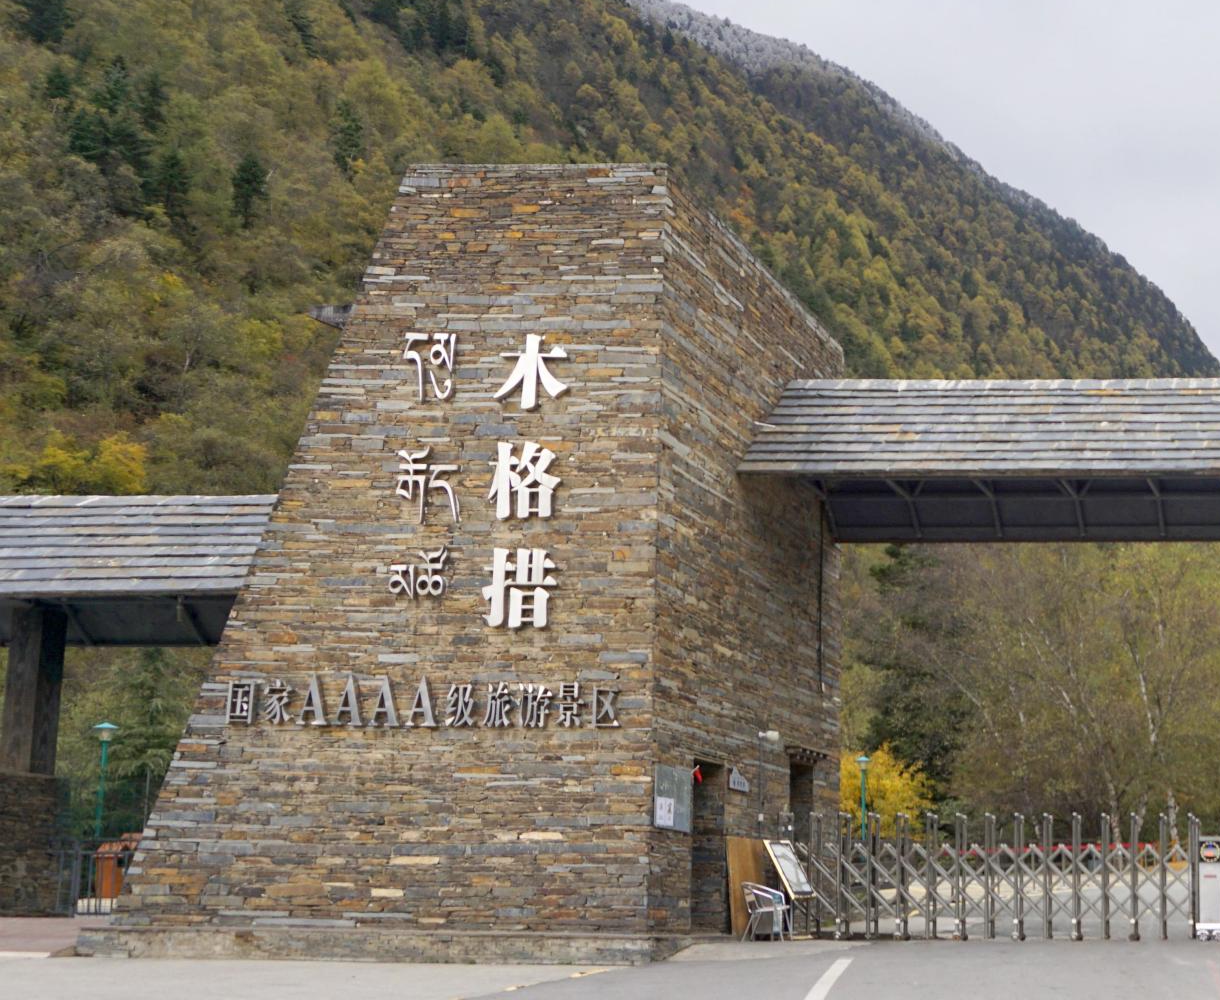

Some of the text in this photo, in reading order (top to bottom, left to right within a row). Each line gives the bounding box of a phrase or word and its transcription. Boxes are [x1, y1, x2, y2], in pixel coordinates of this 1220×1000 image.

[481, 333, 571, 629] 木格措
[225, 673, 622, 728] 国家AAAA级旅游景区
